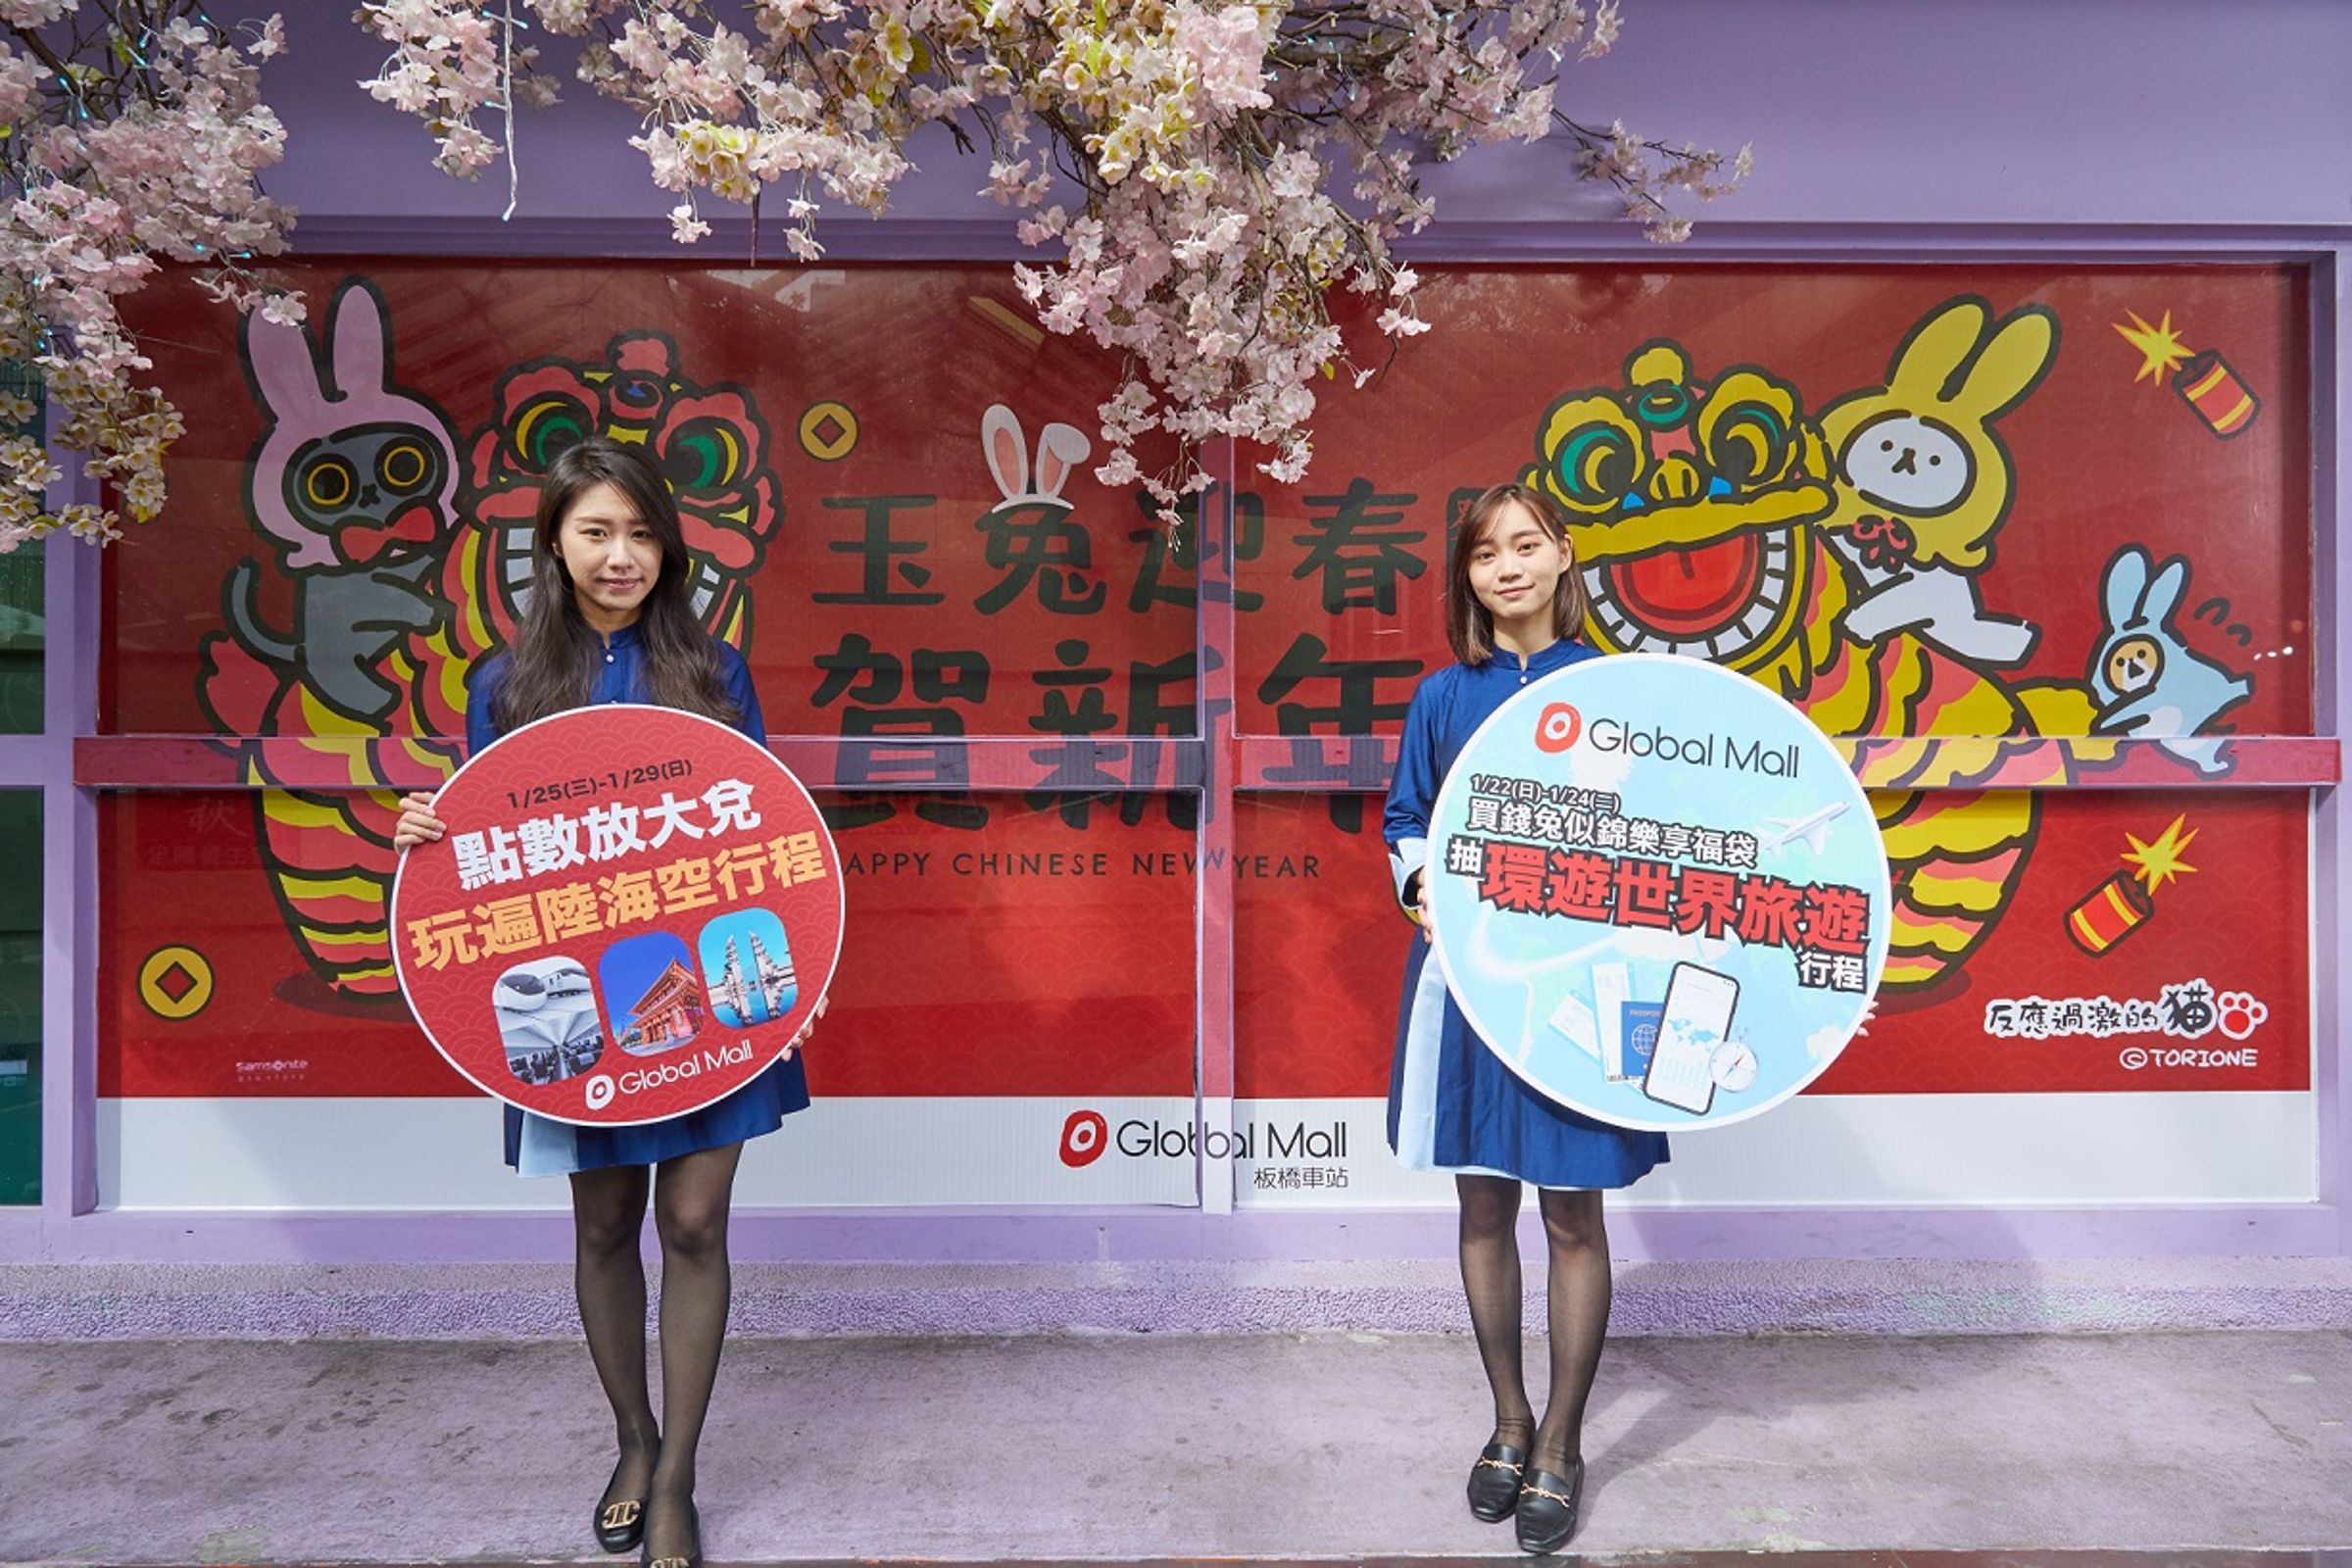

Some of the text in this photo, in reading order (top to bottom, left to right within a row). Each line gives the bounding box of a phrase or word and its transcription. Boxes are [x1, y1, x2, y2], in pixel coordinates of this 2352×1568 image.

[811, 477, 1482, 616] 玉兔迎春
[810, 632, 1426, 833] 賀新年
[1588, 717, 1801, 779] Global Mall
[507, 759, 693, 808] 1/25(三)-1/29(日)
[451, 778, 761, 891] 點數放大兌
[1467, 797, 1759, 867] 買錢兔似錦樂享福袋
[845, 852, 931, 875] APPY
[952, 853, 1108, 876] CHINESE
[1233, 855, 1319, 879] YEAR
[407, 831, 827, 971] 玩遍陸海空行程
[1799, 951, 1867, 992] 行程
[618, 1038, 754, 1095] Global Mall
[1267, 1121, 1347, 1159] Mall
[1253, 1166, 1348, 1190] 板橋車站
